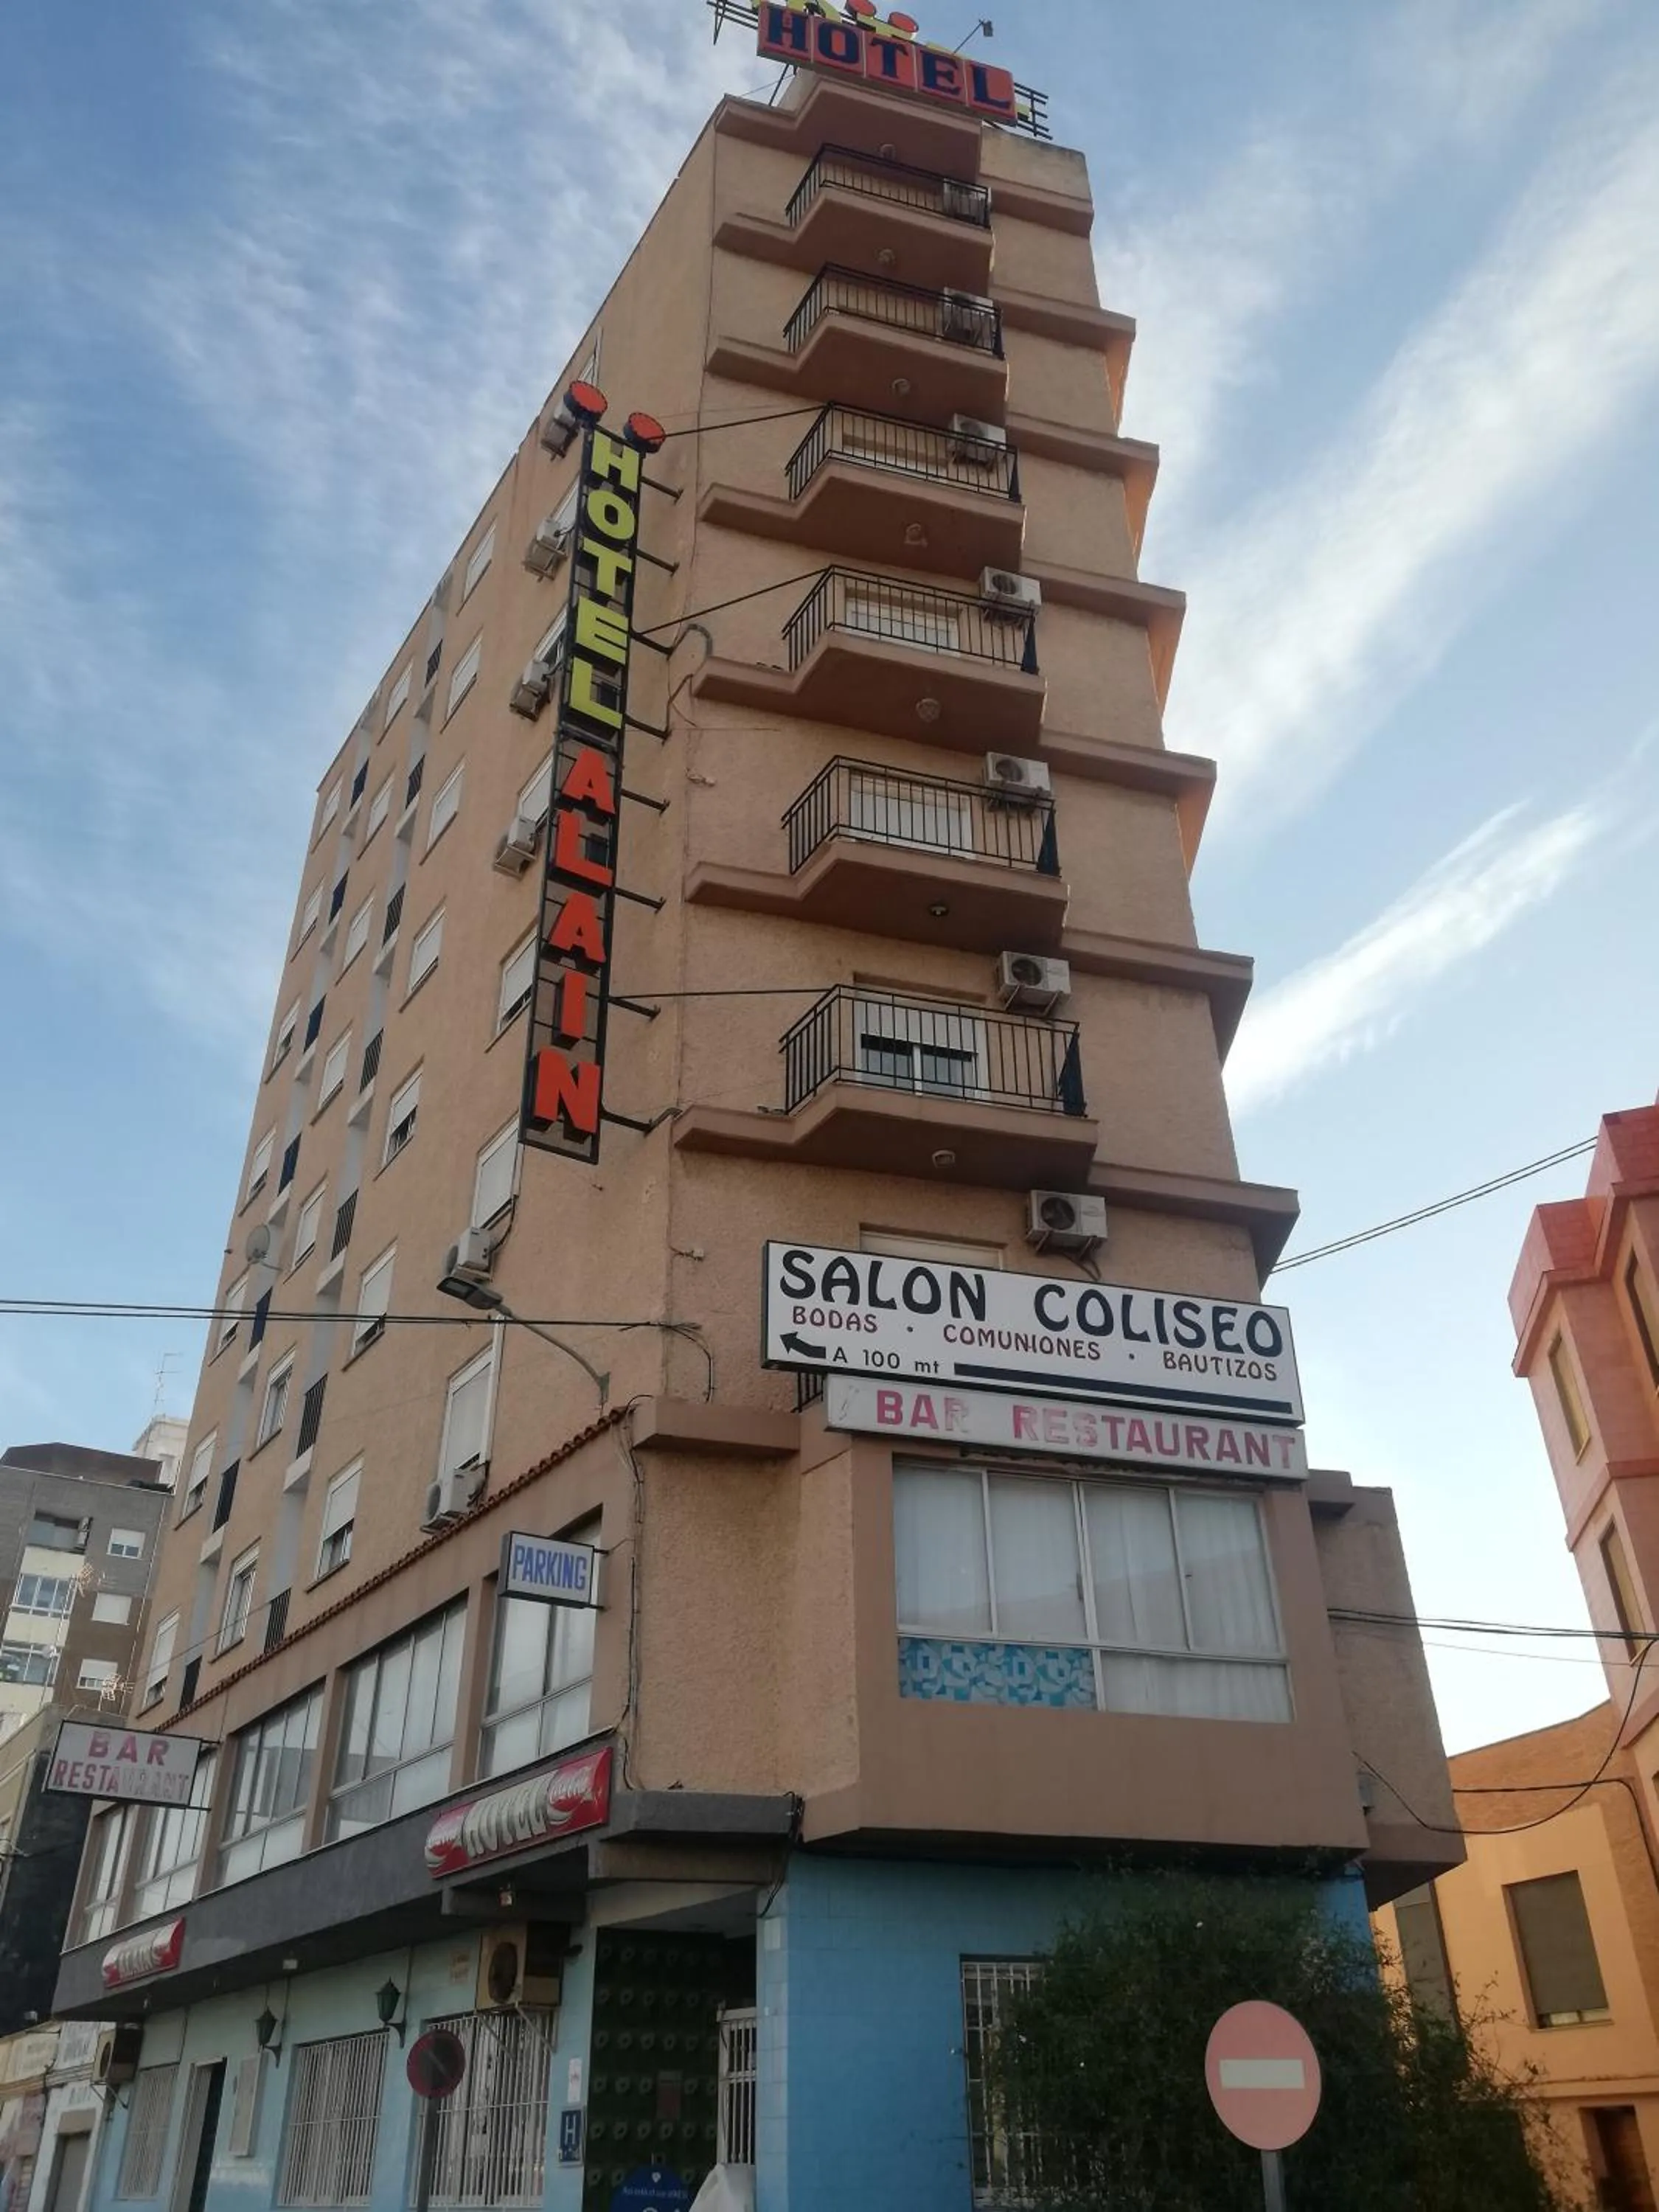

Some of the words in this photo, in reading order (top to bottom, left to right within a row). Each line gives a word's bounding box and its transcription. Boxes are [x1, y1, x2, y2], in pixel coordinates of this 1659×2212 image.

[768, 4, 1011, 108] HOTEL
[571, 430, 640, 729] HOTEL
[534, 746, 615, 1133] ALAIN
[779, 1250, 986, 1322] SALON
[1034, 1284, 1283, 1357] COLISEO
[793, 1306, 878, 1333] BODAS
[943, 1324, 1101, 1360] COMUNIONES
[1164, 1351, 1278, 1381] BAUTIZOS
[832, 1346, 847, 1363] A
[862, 1349, 900, 1370] 100
[914, 1359, 939, 1374] mt
[876, 1388, 969, 1433] BAR
[1012, 1405, 1295, 1470] RESTAURANT
[512, 1544, 588, 1590] PARKING
[88, 1731, 170, 1766] BAR
[564, 2114, 577, 2145] H
